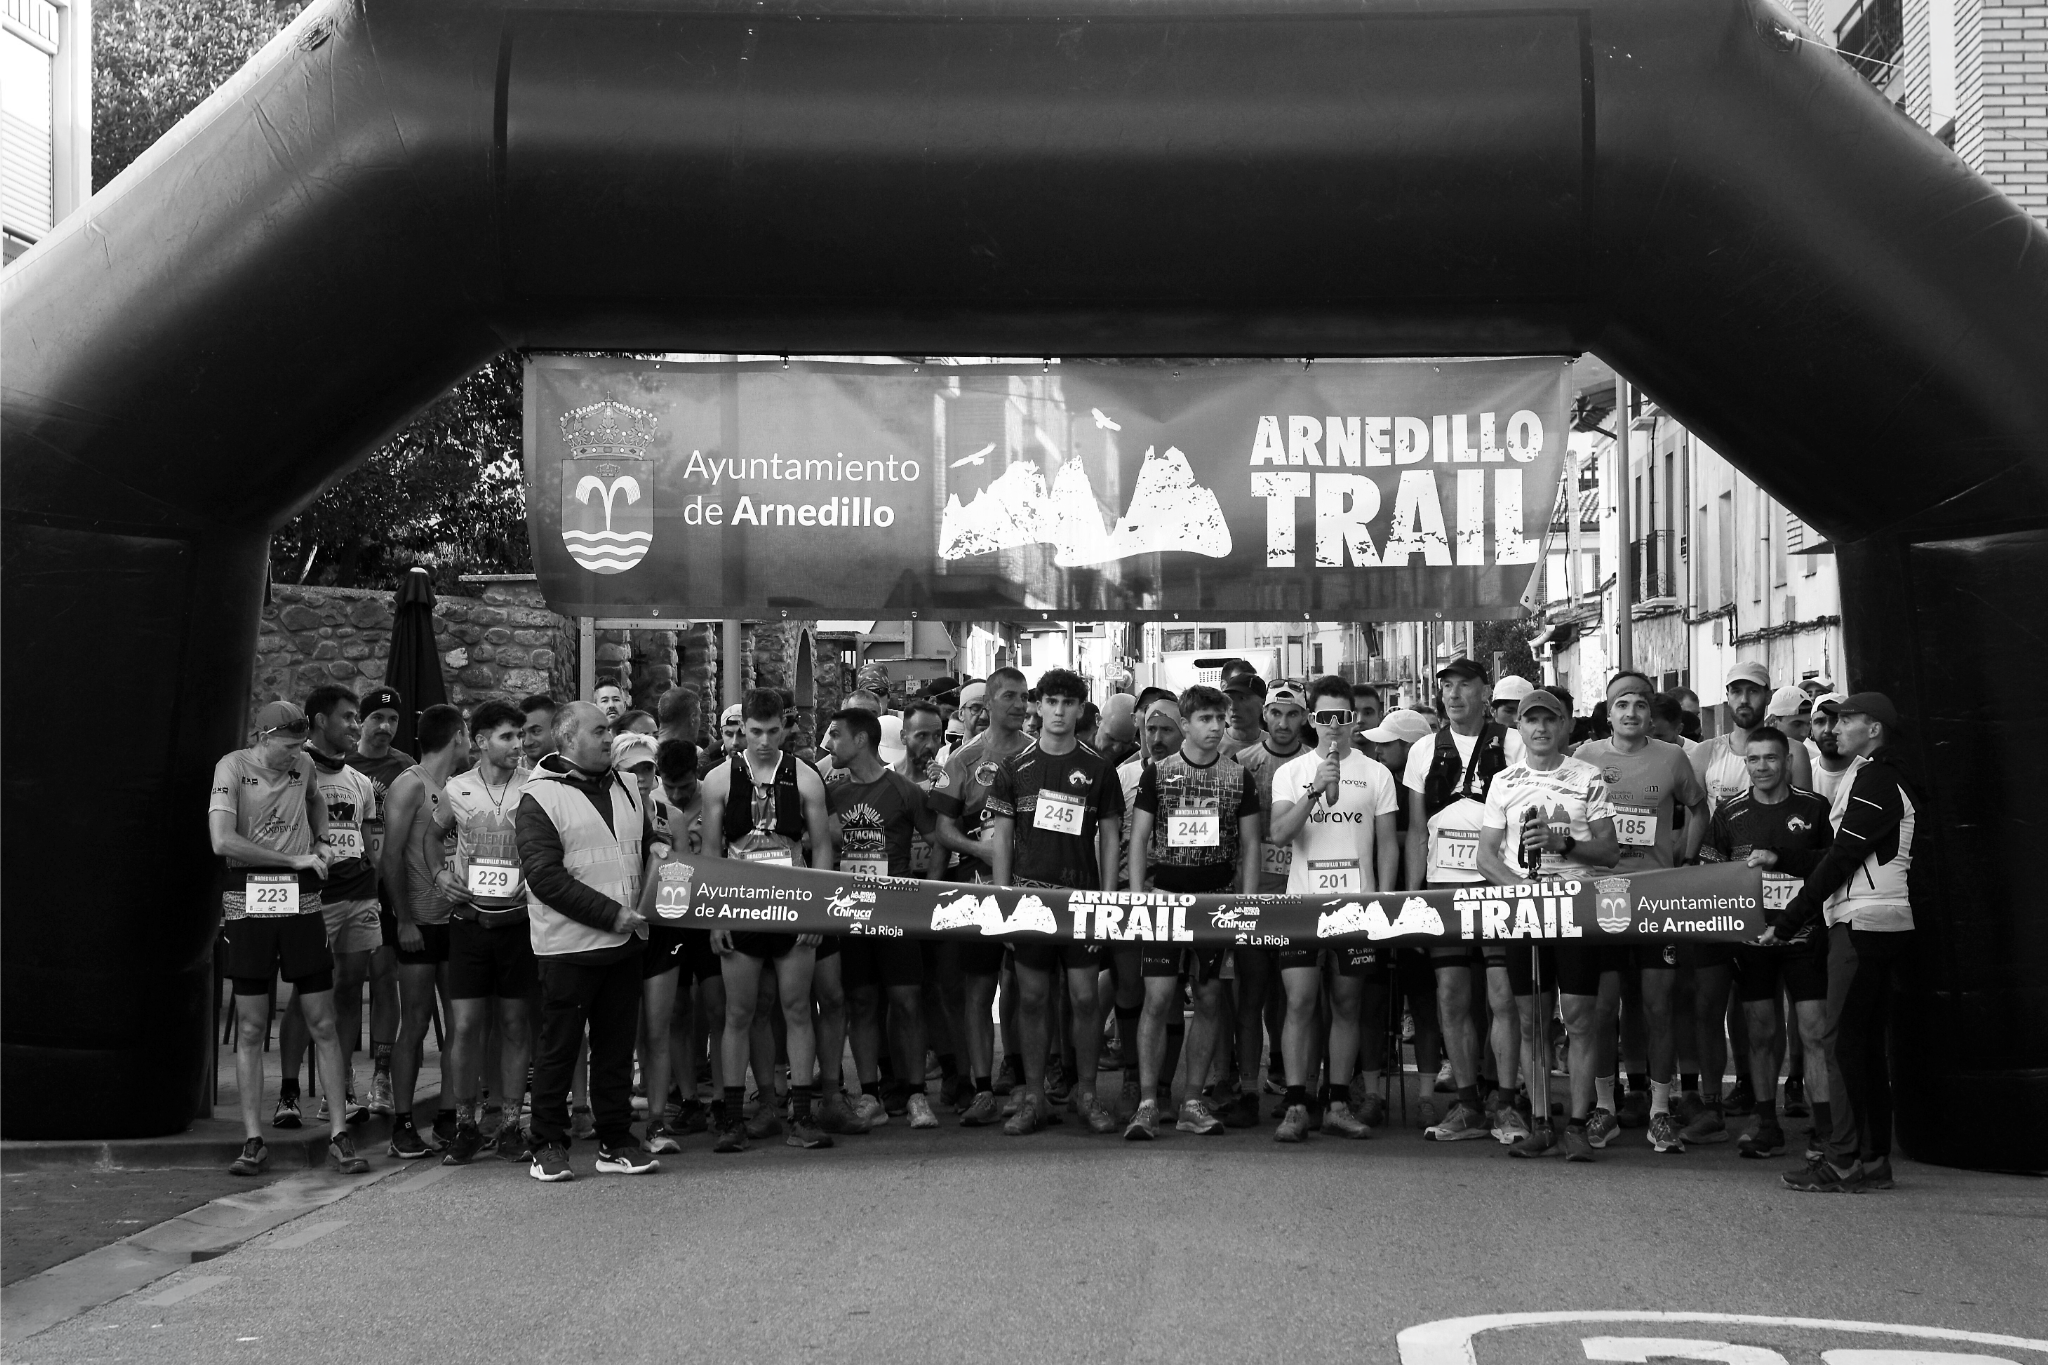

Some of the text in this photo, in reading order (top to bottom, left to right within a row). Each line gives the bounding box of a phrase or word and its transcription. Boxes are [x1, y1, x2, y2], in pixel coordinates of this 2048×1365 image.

[1250, 409, 1544, 467] ARNEDILLO
[683, 449, 920, 489] Ayuntamiento
[683, 495, 895, 528] de Arnedillo
[1250, 468, 1540, 568] TRAIL
[1044, 804, 1074, 823] 245
[1178, 821, 1209, 836] 244
[1616, 818, 1646, 835] 185
[329, 833, 356, 848] 246
[1265, 848, 1293, 865] 203
[1448, 843, 1476, 859] 177
[850, 864, 878, 875] 153
[478, 870, 508, 887] 229
[1319, 873, 1349, 889] 201
[257, 888, 288, 903] 223
[695, 882, 813, 902] Ayuntamiento
[1068, 890, 1197, 907] ARNEDILLO
[1454, 880, 1582, 901] ARNEDILLO
[1763, 885, 1794, 900] 217
[694, 902, 799, 922] de Arnedillo
[833, 906, 872, 918] Chiruca
[1637, 894, 1756, 914] Ayuntamiento
[1068, 903, 1195, 942] TRAIL
[1217, 919, 1257, 929] Chiruca
[1453, 897, 1583, 940] TRAIL
[1638, 915, 1745, 934] de Arnedillo
[865, 924, 904, 938] La Rioja
[1250, 935, 1290, 947] La Rioja
